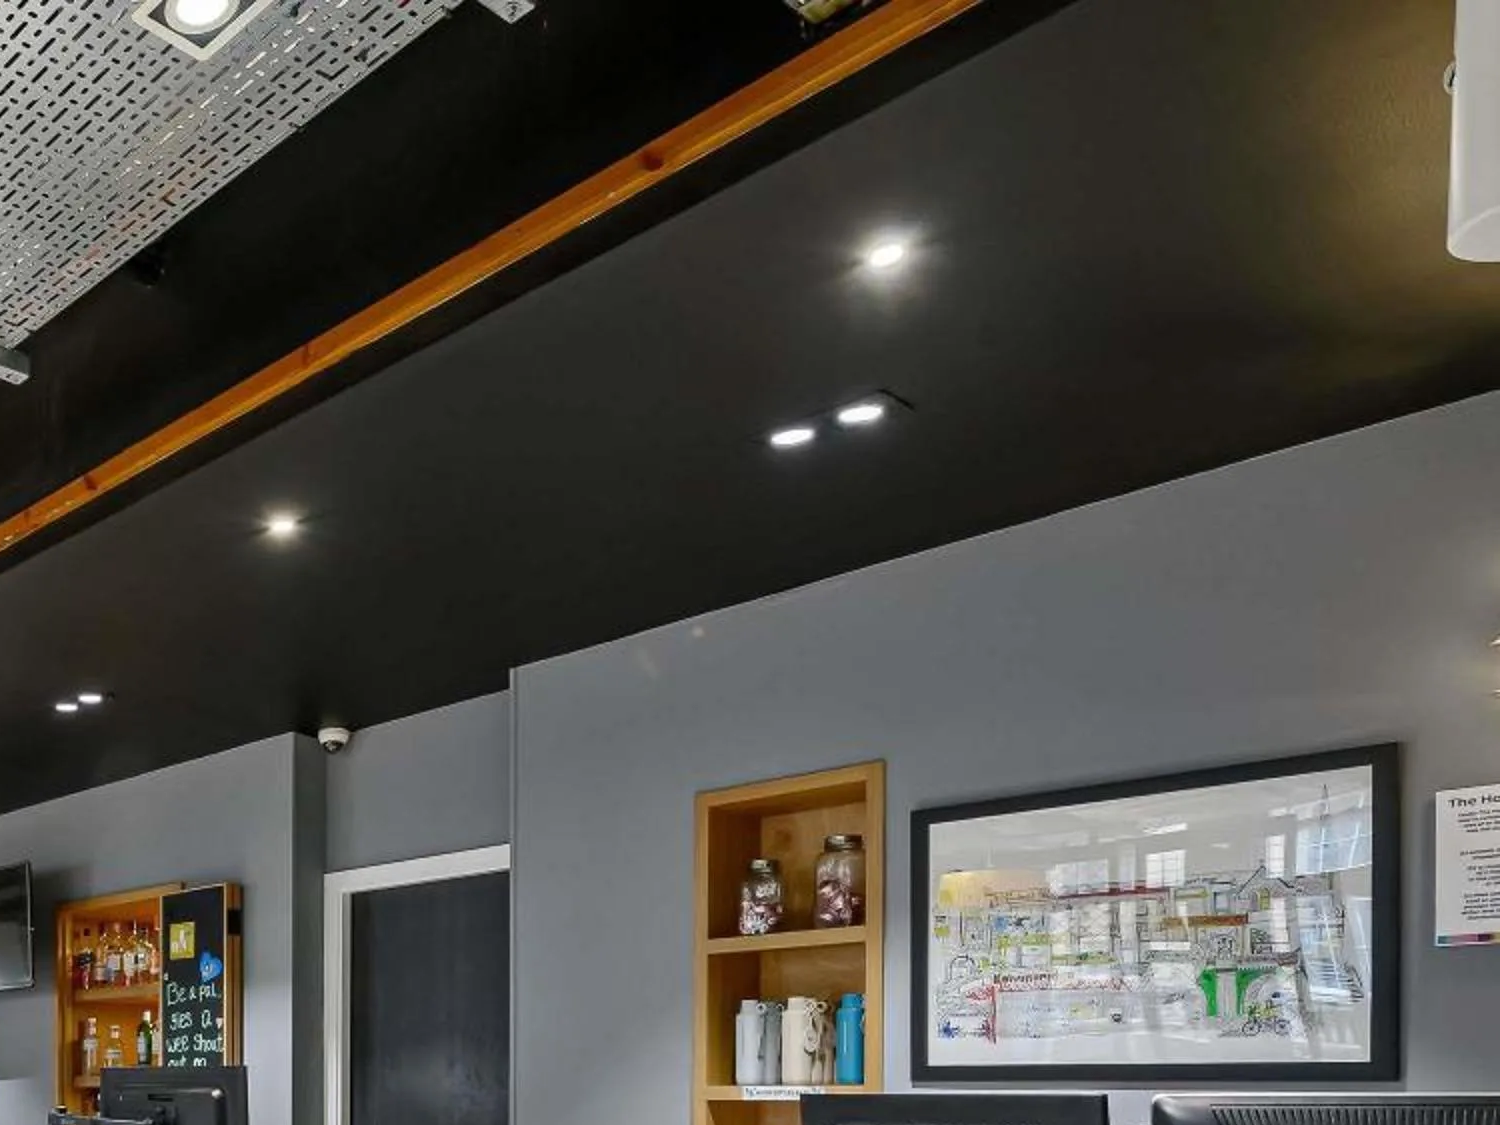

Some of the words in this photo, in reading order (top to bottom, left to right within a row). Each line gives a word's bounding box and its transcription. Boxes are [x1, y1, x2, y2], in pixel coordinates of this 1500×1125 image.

[1448, 797, 1477, 808] The
[167, 982, 187, 1006] Be
[189, 985, 197, 1001] a
